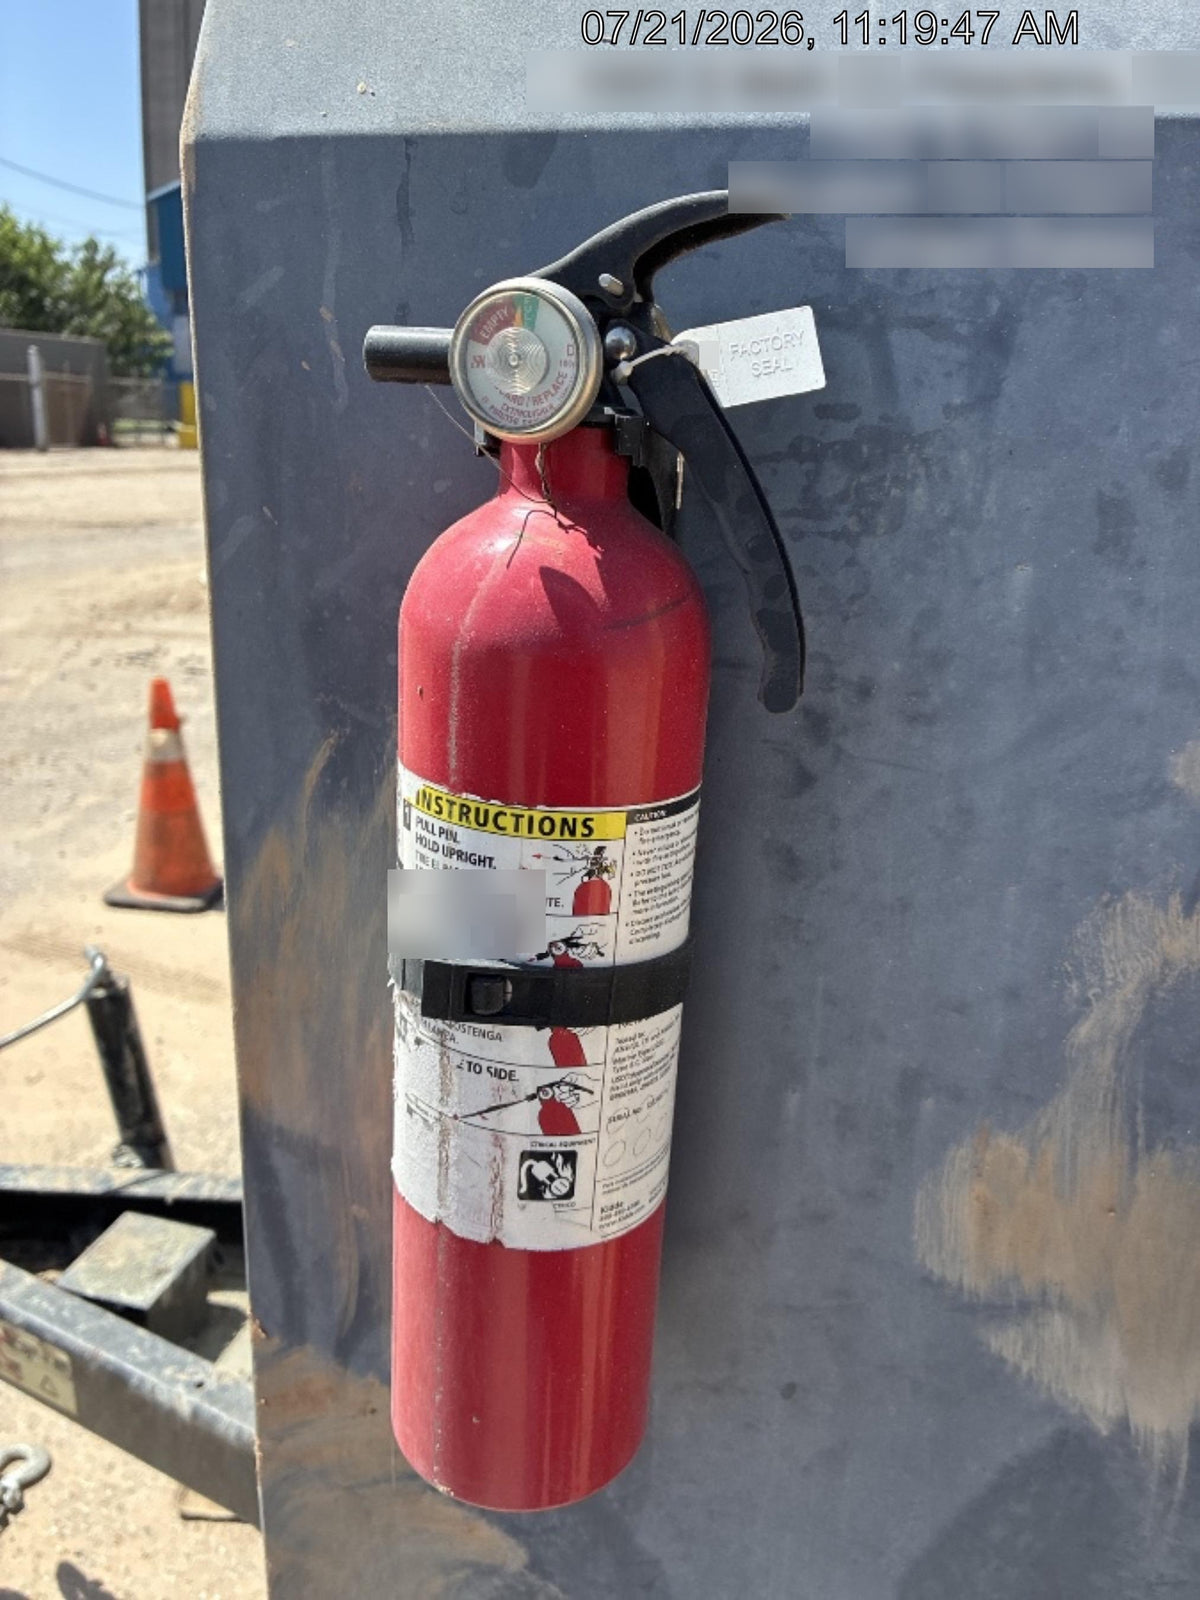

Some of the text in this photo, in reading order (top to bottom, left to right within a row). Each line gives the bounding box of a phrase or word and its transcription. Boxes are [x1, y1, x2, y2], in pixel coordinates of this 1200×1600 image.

[479, 305, 509, 339] EMPTY
[730, 329, 804, 361] FACTORY
[752, 357, 793, 379] SEAL
[531, 371, 569, 406] REPLACE
[415, 815, 460, 844] PULL PIN.
[416, 788, 596, 838] INSTRUCTIONS
[415, 832, 497, 870] HOLD UPRIGHT.
[466, 1060, 483, 1075] TO
[486, 1064, 520, 1083] SIDE.
